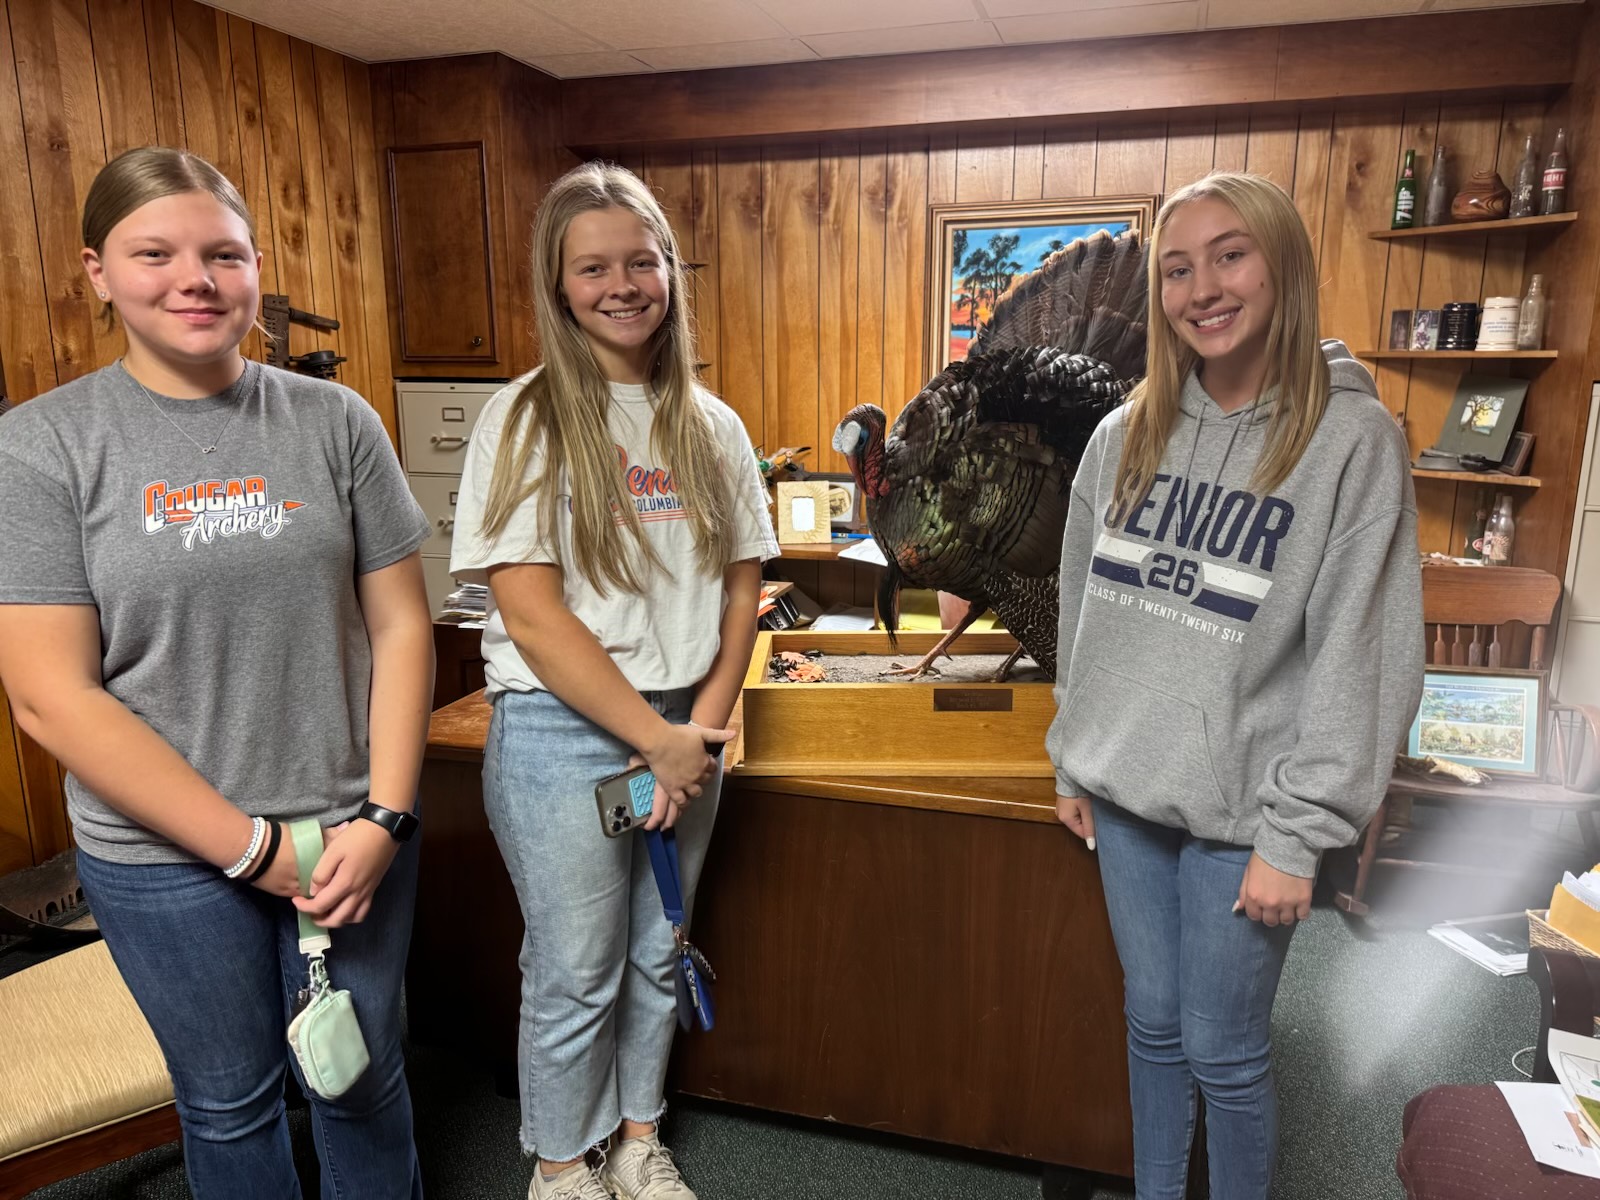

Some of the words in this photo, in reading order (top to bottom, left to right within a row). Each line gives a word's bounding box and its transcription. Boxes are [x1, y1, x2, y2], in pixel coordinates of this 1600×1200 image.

[142, 475, 268, 535] COUGAR
[180, 500, 292, 550] Archery
[1147, 552, 1199, 597] 26
[1088, 582, 1116, 602] CLASS
[1119, 593, 1135, 606] OF
[1138, 598, 1179, 621] TWENTY
[1180, 612, 1219, 636] TWENTY
[1221, 627, 1246, 644] SIX
